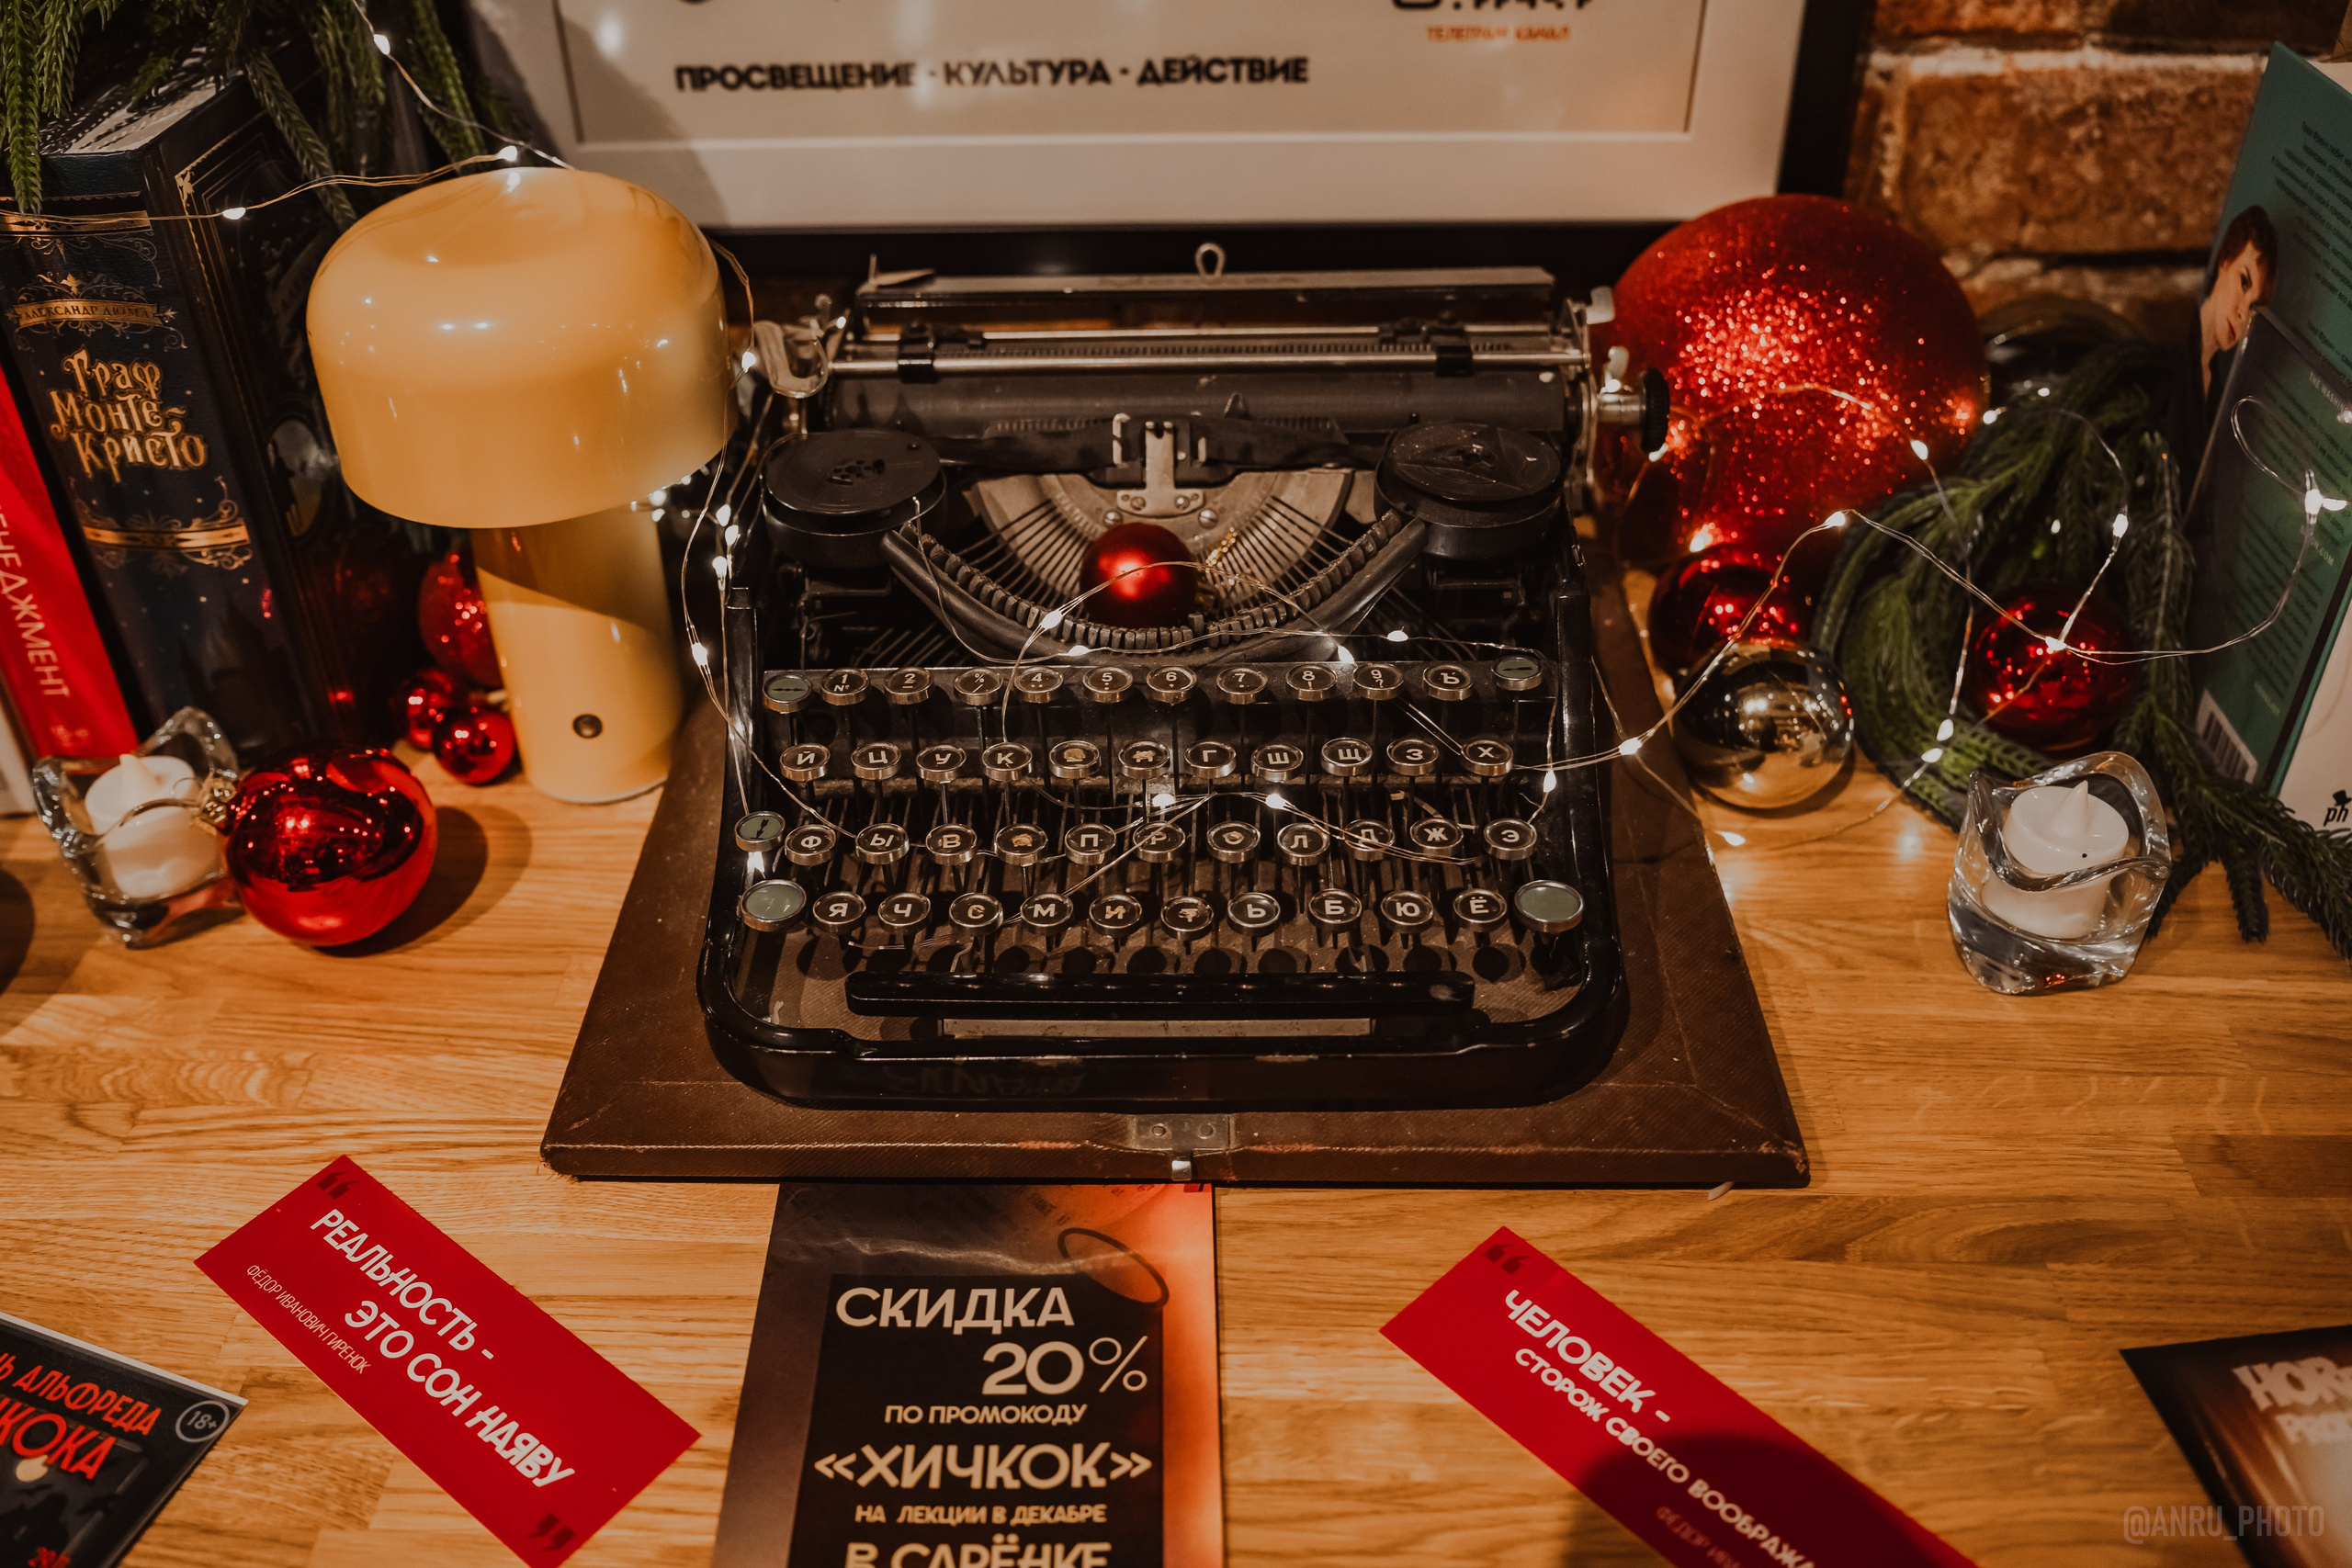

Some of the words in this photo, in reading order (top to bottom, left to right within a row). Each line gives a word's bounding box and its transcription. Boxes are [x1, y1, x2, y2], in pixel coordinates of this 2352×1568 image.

[676, 62, 916, 92] ПРОСВЕЩЕНИЕ
[943, 61, 1113, 86] КУЛЬТУРА
[1137, 54, 1310, 87] ДЕЙСТВИЕ
[24, 305, 98, 321] АЛЕКСАНДР
[62, 345, 162, 400] Граф
[2309, 371, 2321, 389] THE
[70, 421, 208, 484] Кристо
[842, 674, 848, 684] 1
[904, 673, 916, 684] 2
[1031, 673, 1042, 682] 4
[1102, 673, 1113, 682] 5
[1166, 672, 1177, 682] 6
[1235, 673, 1246, 682] 7
[1302, 671, 1315, 681] 8
[1371, 670, 1382, 679] 9
[797, 751, 815, 765] Й
[868, 750, 888, 763] Ц
[935, 753, 951, 764] У
[997, 752, 1013, 765] К
[1203, 750, 1217, 762] Г
[1268, 752, 1290, 764] Ш
[1338, 748, 1362, 761] Щ
[1477, 747, 1495, 759] Х
[801, 836, 821, 848] Ф
[869, 834, 894, 846] Ы
[942, 834, 961, 848] В
[1080, 834, 1098, 847] П
[1290, 835, 1308, 849] Л
[1426, 828, 1448, 841] Ж
[1501, 829, 1519, 842] Э
[829, 903, 848, 917] Я
[894, 903, 912, 917] Ч
[1033, 903, 1056, 919] М
[1247, 904, 1266, 918] Ь
[1324, 900, 1346, 915] Б
[1396, 902, 1420, 917] Ю
[1469, 897, 1489, 915] Ё
[311, 1209, 481, 1351] РЕАЛЬНОСТЬ
[246, 1265, 283, 1293] ФЁДОР
[275, 1291, 331, 1341] ИВАНОВИЧ
[326, 1331, 372, 1374] ГИРЕНОК
[836, 1287, 1075, 1335] СКИДКА
[981, 1336, 1148, 1395] 20%
[1505, 1289, 1657, 1414] ЧЕЛОВЕК
[12, 1365, 162, 1436] АЛЬФРЕДА
[345, 1301, 413, 1359] ЭТО
[406, 1353, 482, 1417] СОН
[465, 1405, 575, 1488] НАЯВУ
[884, 1404, 922, 1425] ПО
[928, 1404, 1087, 1426] ПРОМОКОДУ
[0, 1397, 117, 1480] КОКА
[187, 1411, 217, 1430] 18+
[814, 1442, 1153, 1489] «ХИЧКОК»
[1515, 1348, 1610, 1422] СТОРОЖ
[1606, 1417, 1690, 1483] СВОЕГО
[1688, 1479, 1815, 1568] ВООБРАЖ
[854, 1505, 887, 1524] НА
[896, 1506, 988, 1527] ЛЕКЦИИ
[991, 1506, 1007, 1524] В
[1010, 1504, 1108, 1527] ДЕКАБРЕ
